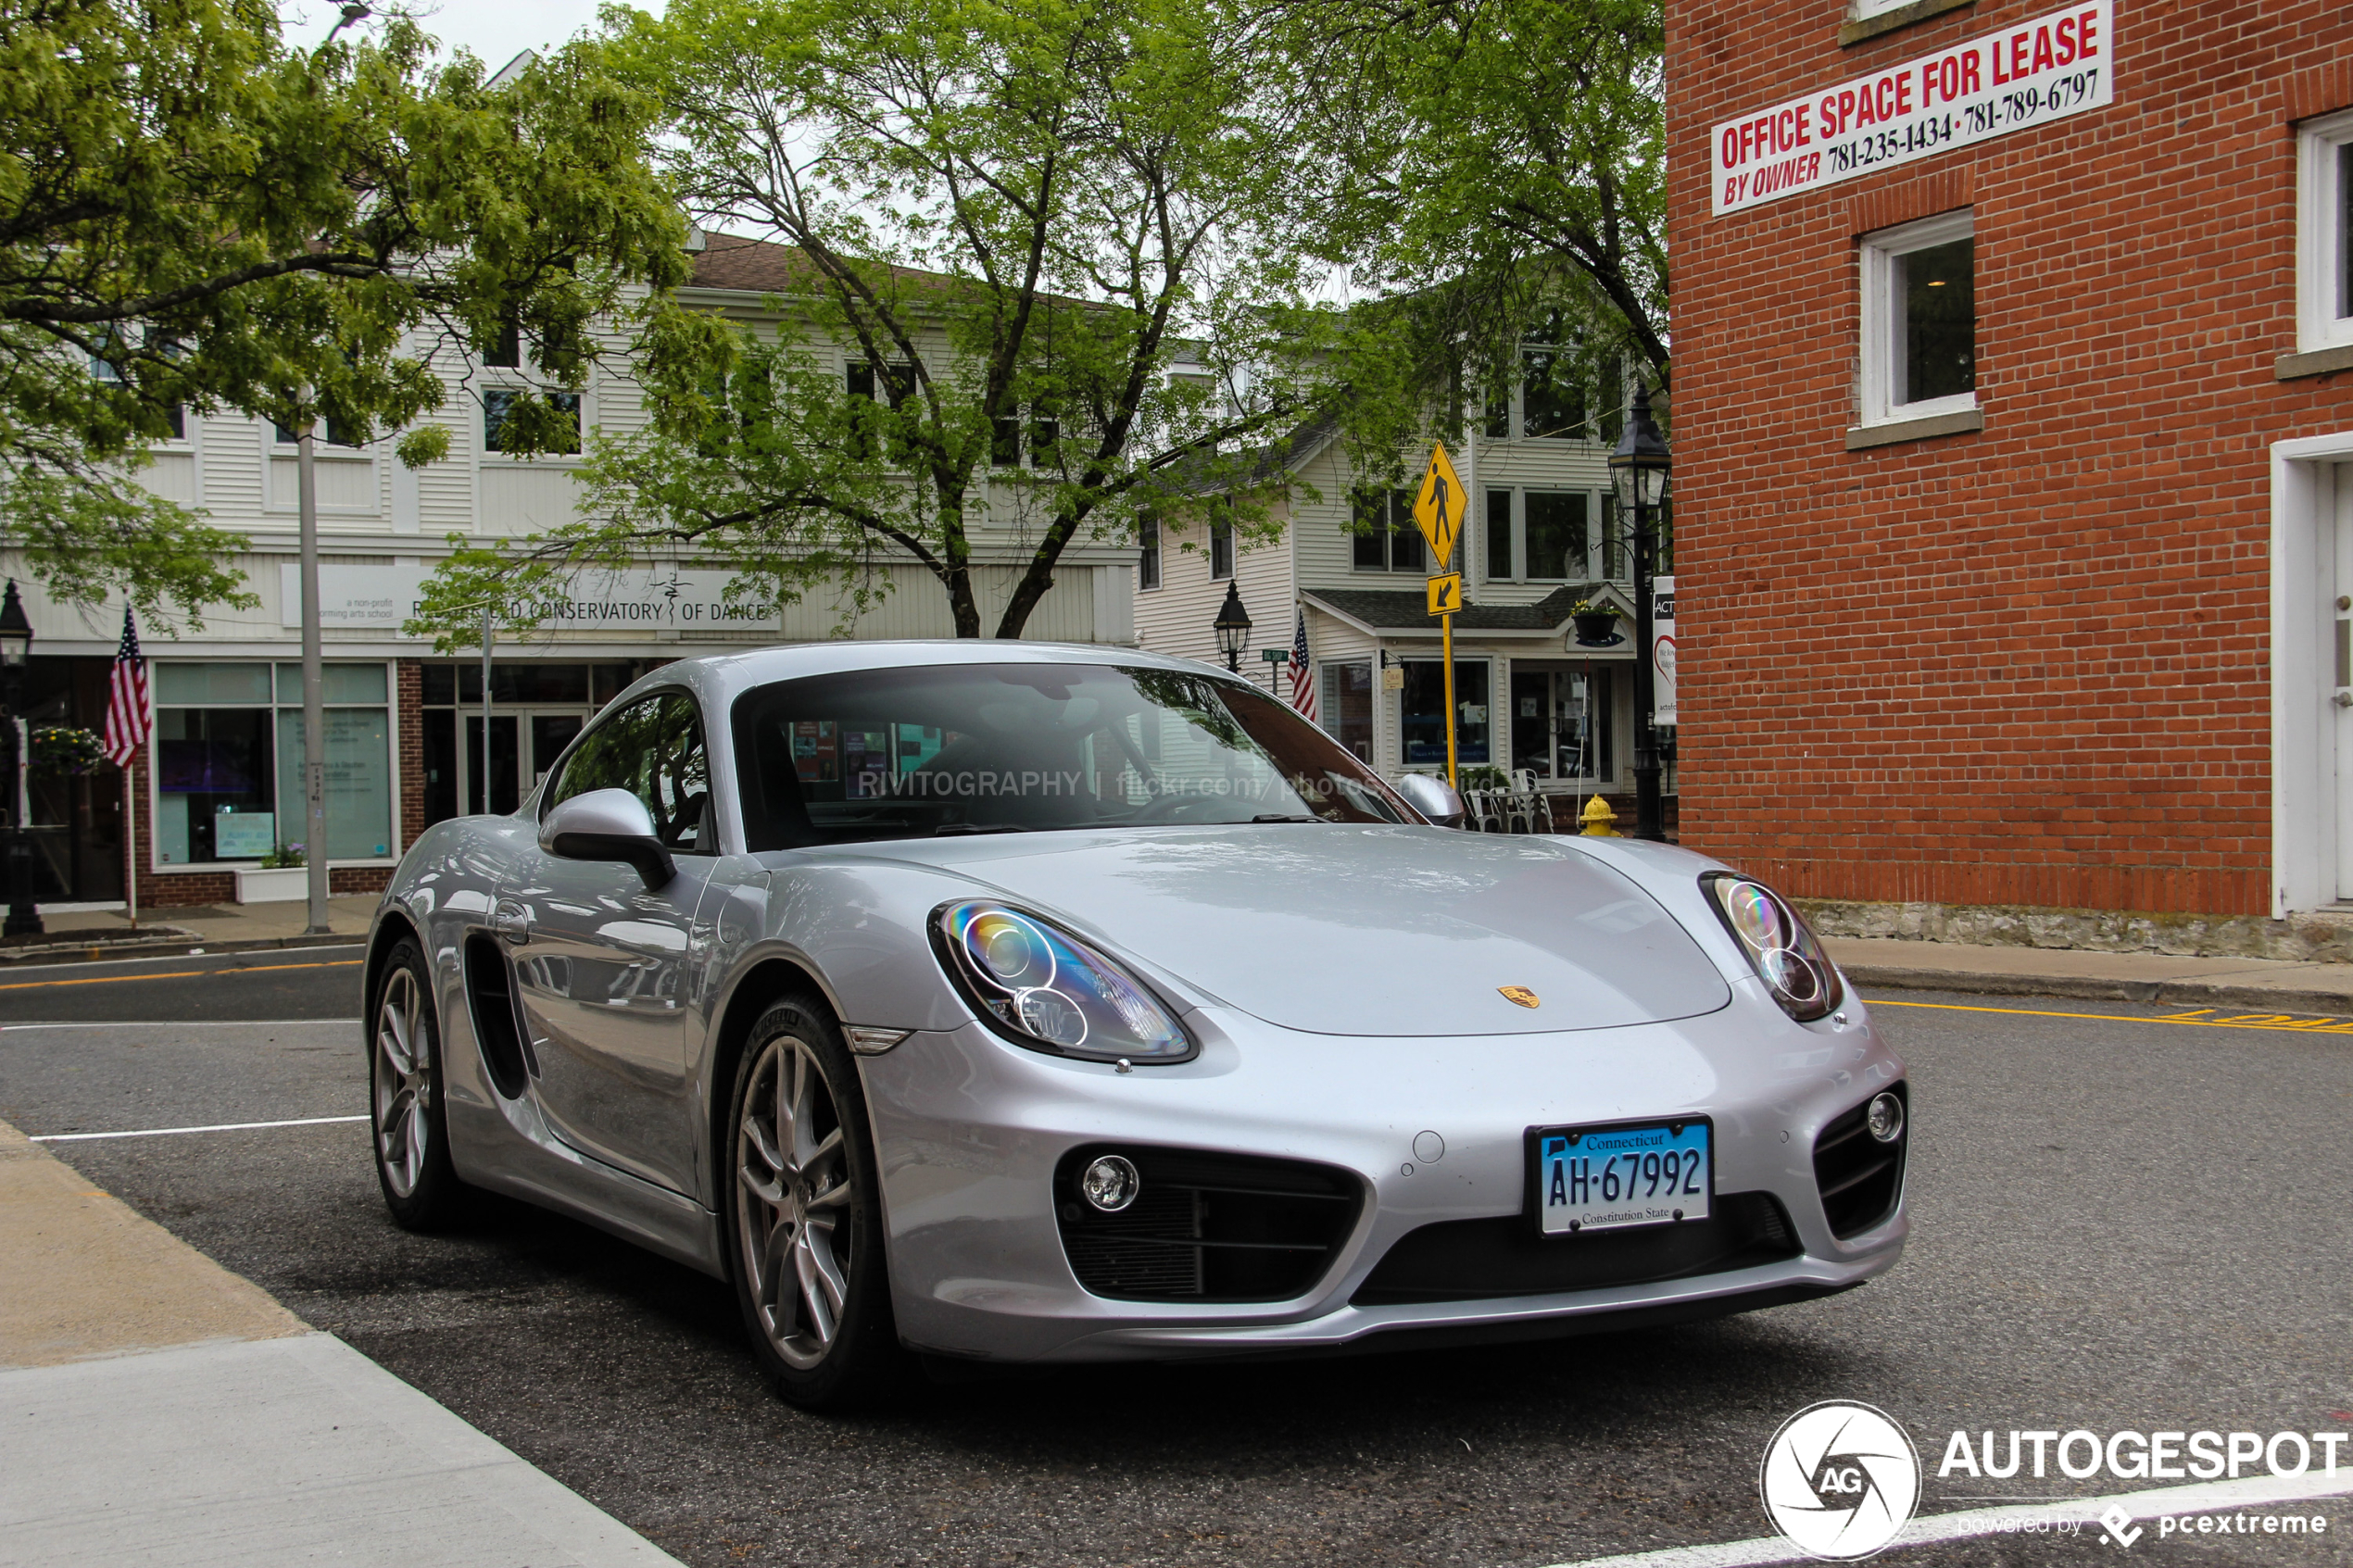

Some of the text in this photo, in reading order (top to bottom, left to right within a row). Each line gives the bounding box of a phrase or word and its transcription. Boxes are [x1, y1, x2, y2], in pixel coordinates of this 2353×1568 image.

[1721, 10, 2098, 169] OFFICE SPACE FOR LEASE
[1724, 69, 2098, 206] BY OWNER 781-235-1434 781-789-6797
[354, 598, 393, 608] non-profit
[530, 602, 661, 621] CONSERVATORY
[683, 603, 703, 621] OF
[711, 604, 765, 621] DANCE
[320, 608, 393, 620] orming arts school
[756, 1010, 798, 1035] MICHELIN
[1586, 1134, 1664, 1151] Connecticut
[1581, 1207, 1669, 1225] Constitution State
